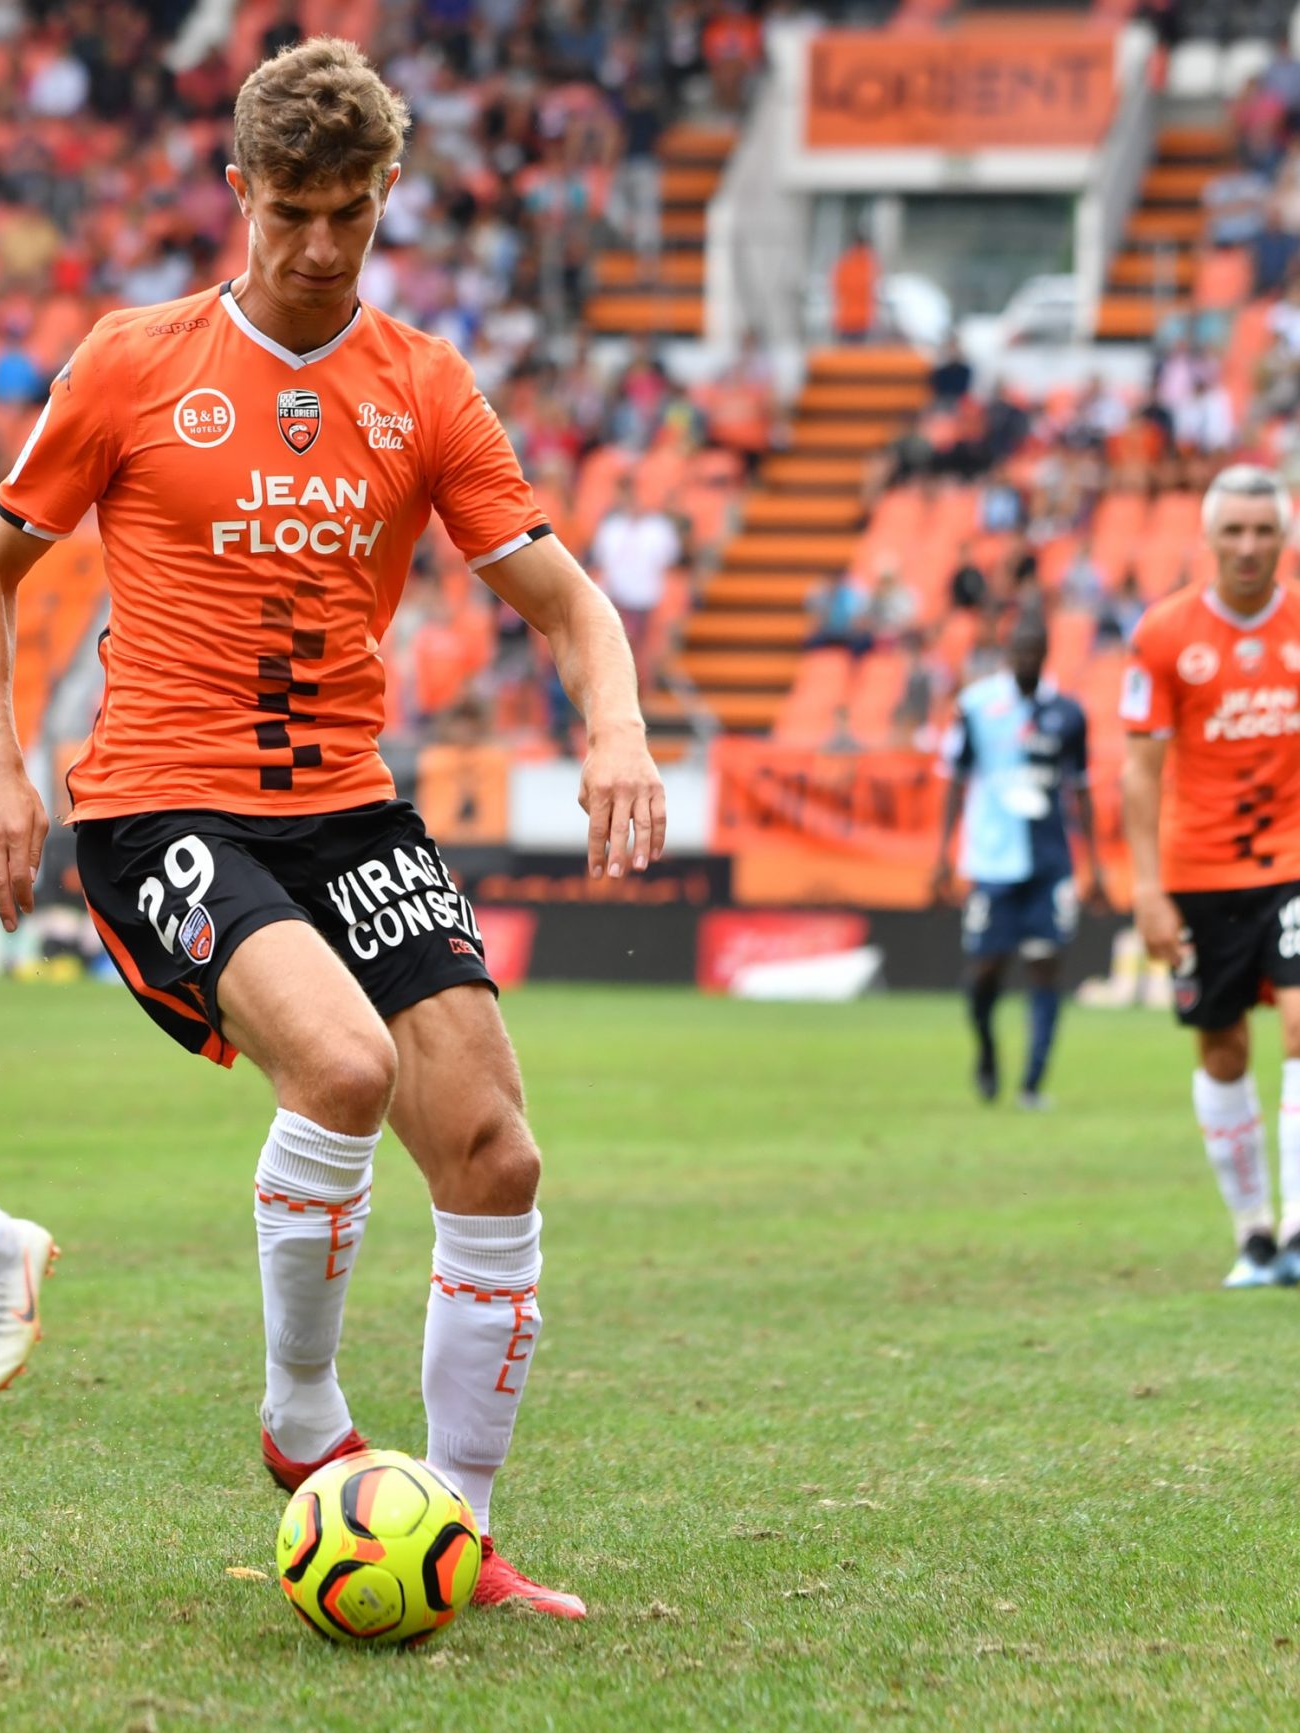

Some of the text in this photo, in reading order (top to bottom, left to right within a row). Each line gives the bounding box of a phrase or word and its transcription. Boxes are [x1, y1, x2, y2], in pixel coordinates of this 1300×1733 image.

[145, 318, 209, 337] Kappa
[183, 406, 228, 427] B&B
[279, 408, 319, 418] FC LORIENT
[356, 402, 414, 434] Breizh
[190, 426, 222, 434] HOTELS
[368, 427, 404, 450] Cola
[236, 470, 367, 513] JEAN
[212, 515, 384, 557] FLOC'H
[137, 834, 215, 955] 29
[347, 890, 483, 960] CONSEIL
[494, 1304, 534, 1395] FCL
